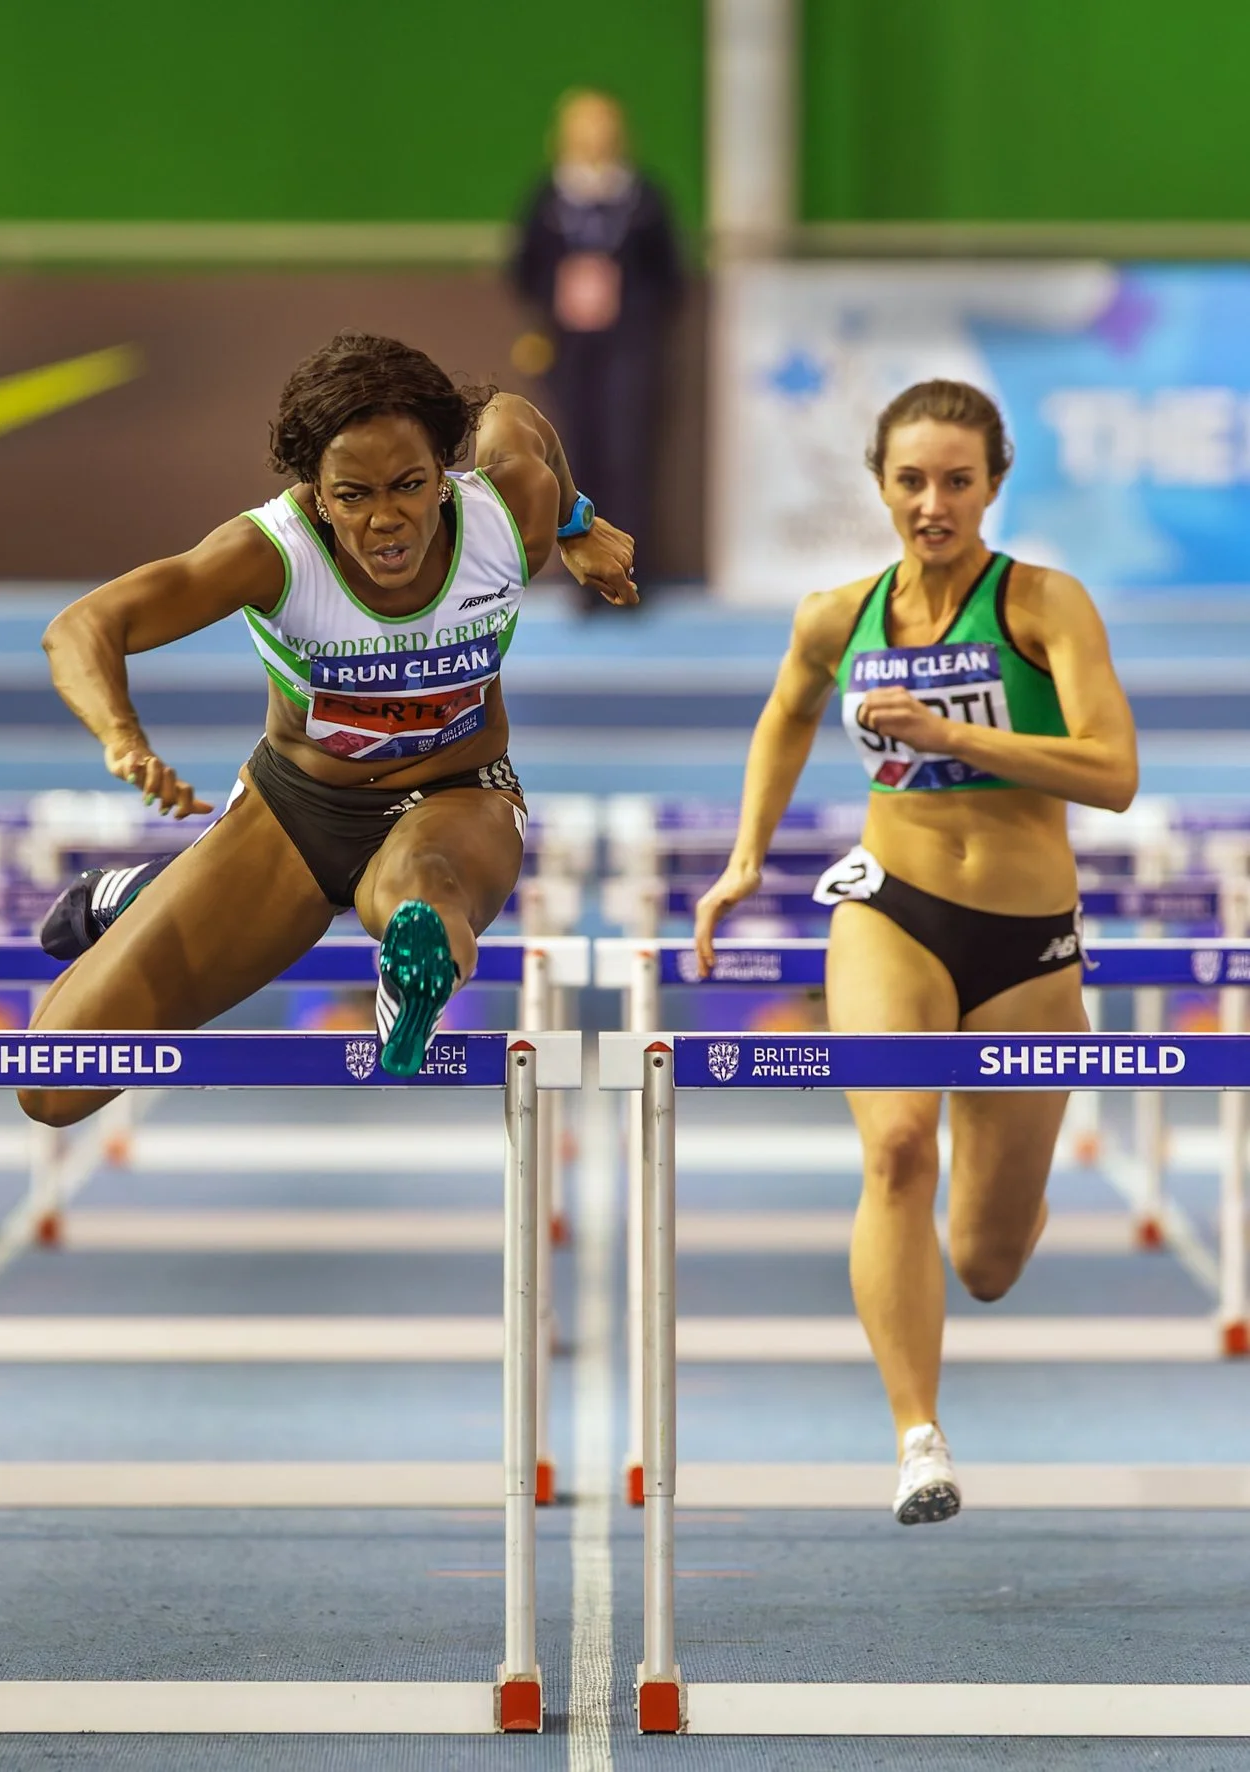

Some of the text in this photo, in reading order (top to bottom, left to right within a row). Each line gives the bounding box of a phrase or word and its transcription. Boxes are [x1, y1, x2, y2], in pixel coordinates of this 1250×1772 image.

[285, 631, 429, 657] WOODFORD
[322, 648, 489, 683] I RUN CLEAN
[855, 652, 990, 681] I RUN CLEAN
[440, 715, 477, 740] BRITISH
[440, 721, 478, 746] ATHLETICS
[425, 1046, 466, 1061] TISH
[754, 1047, 830, 1063] BRITISH
[979, 1045, 1186, 1075] SHEFFIELD
[418, 1063, 468, 1075] LETICS
[752, 1064, 831, 1077] ATHLETICS
